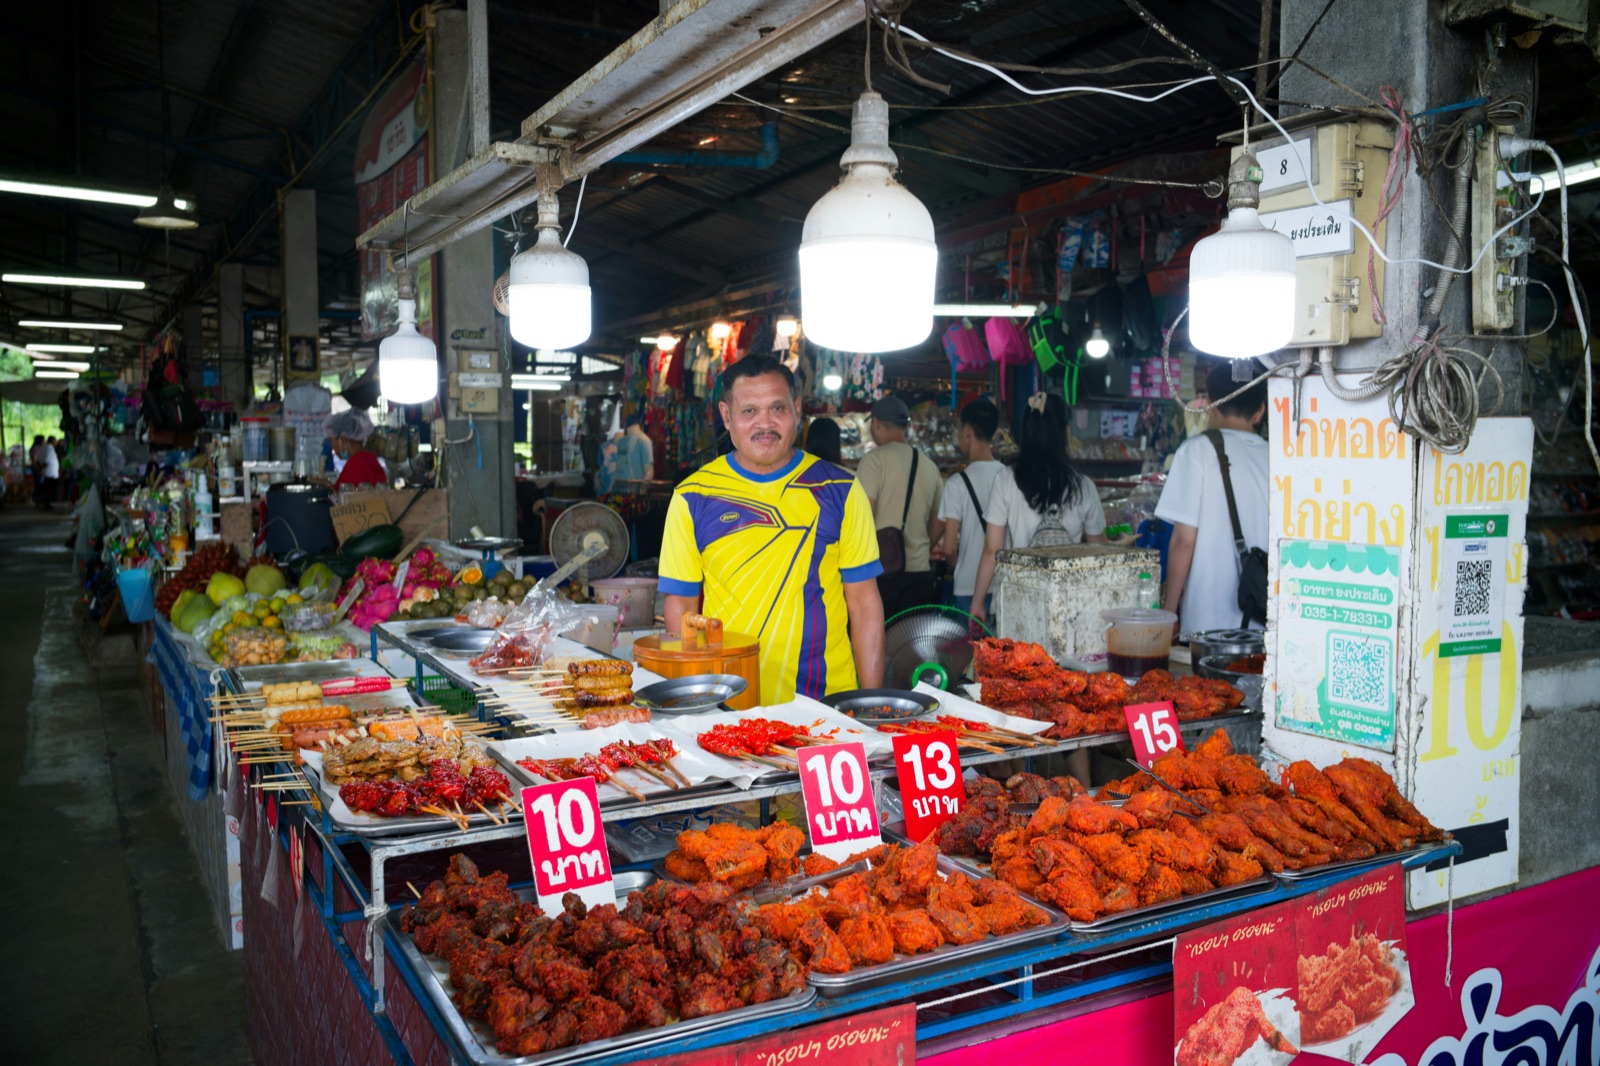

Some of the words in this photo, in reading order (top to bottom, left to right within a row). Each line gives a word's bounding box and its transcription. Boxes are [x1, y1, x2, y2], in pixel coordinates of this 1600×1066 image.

[1279, 158, 1288, 176] 8
[1290, 215, 1342, 240] ยงประเดิม
[1273, 396, 1407, 460] ไก่ทอด
[1273, 474, 1406, 547] ไก่ย่าง
[1303, 584, 1334, 597] อารยา
[1336, 586, 1387, 603] ยงประเดิม
[1304, 605, 1388, 627] 035-1-78331-1
[1420, 618, 1517, 763] 10
[1133, 709, 1178, 755] 15
[1337, 719, 1352, 730] QR
[1354, 723, 1382, 736] CODE
[806, 750, 864, 807] 10
[903, 741, 956, 791] 13
[531, 788, 595, 853] 10
[815, 807, 873, 838] บาท
[912, 795, 959, 819] บาท
[541, 849, 606, 886] บาท
